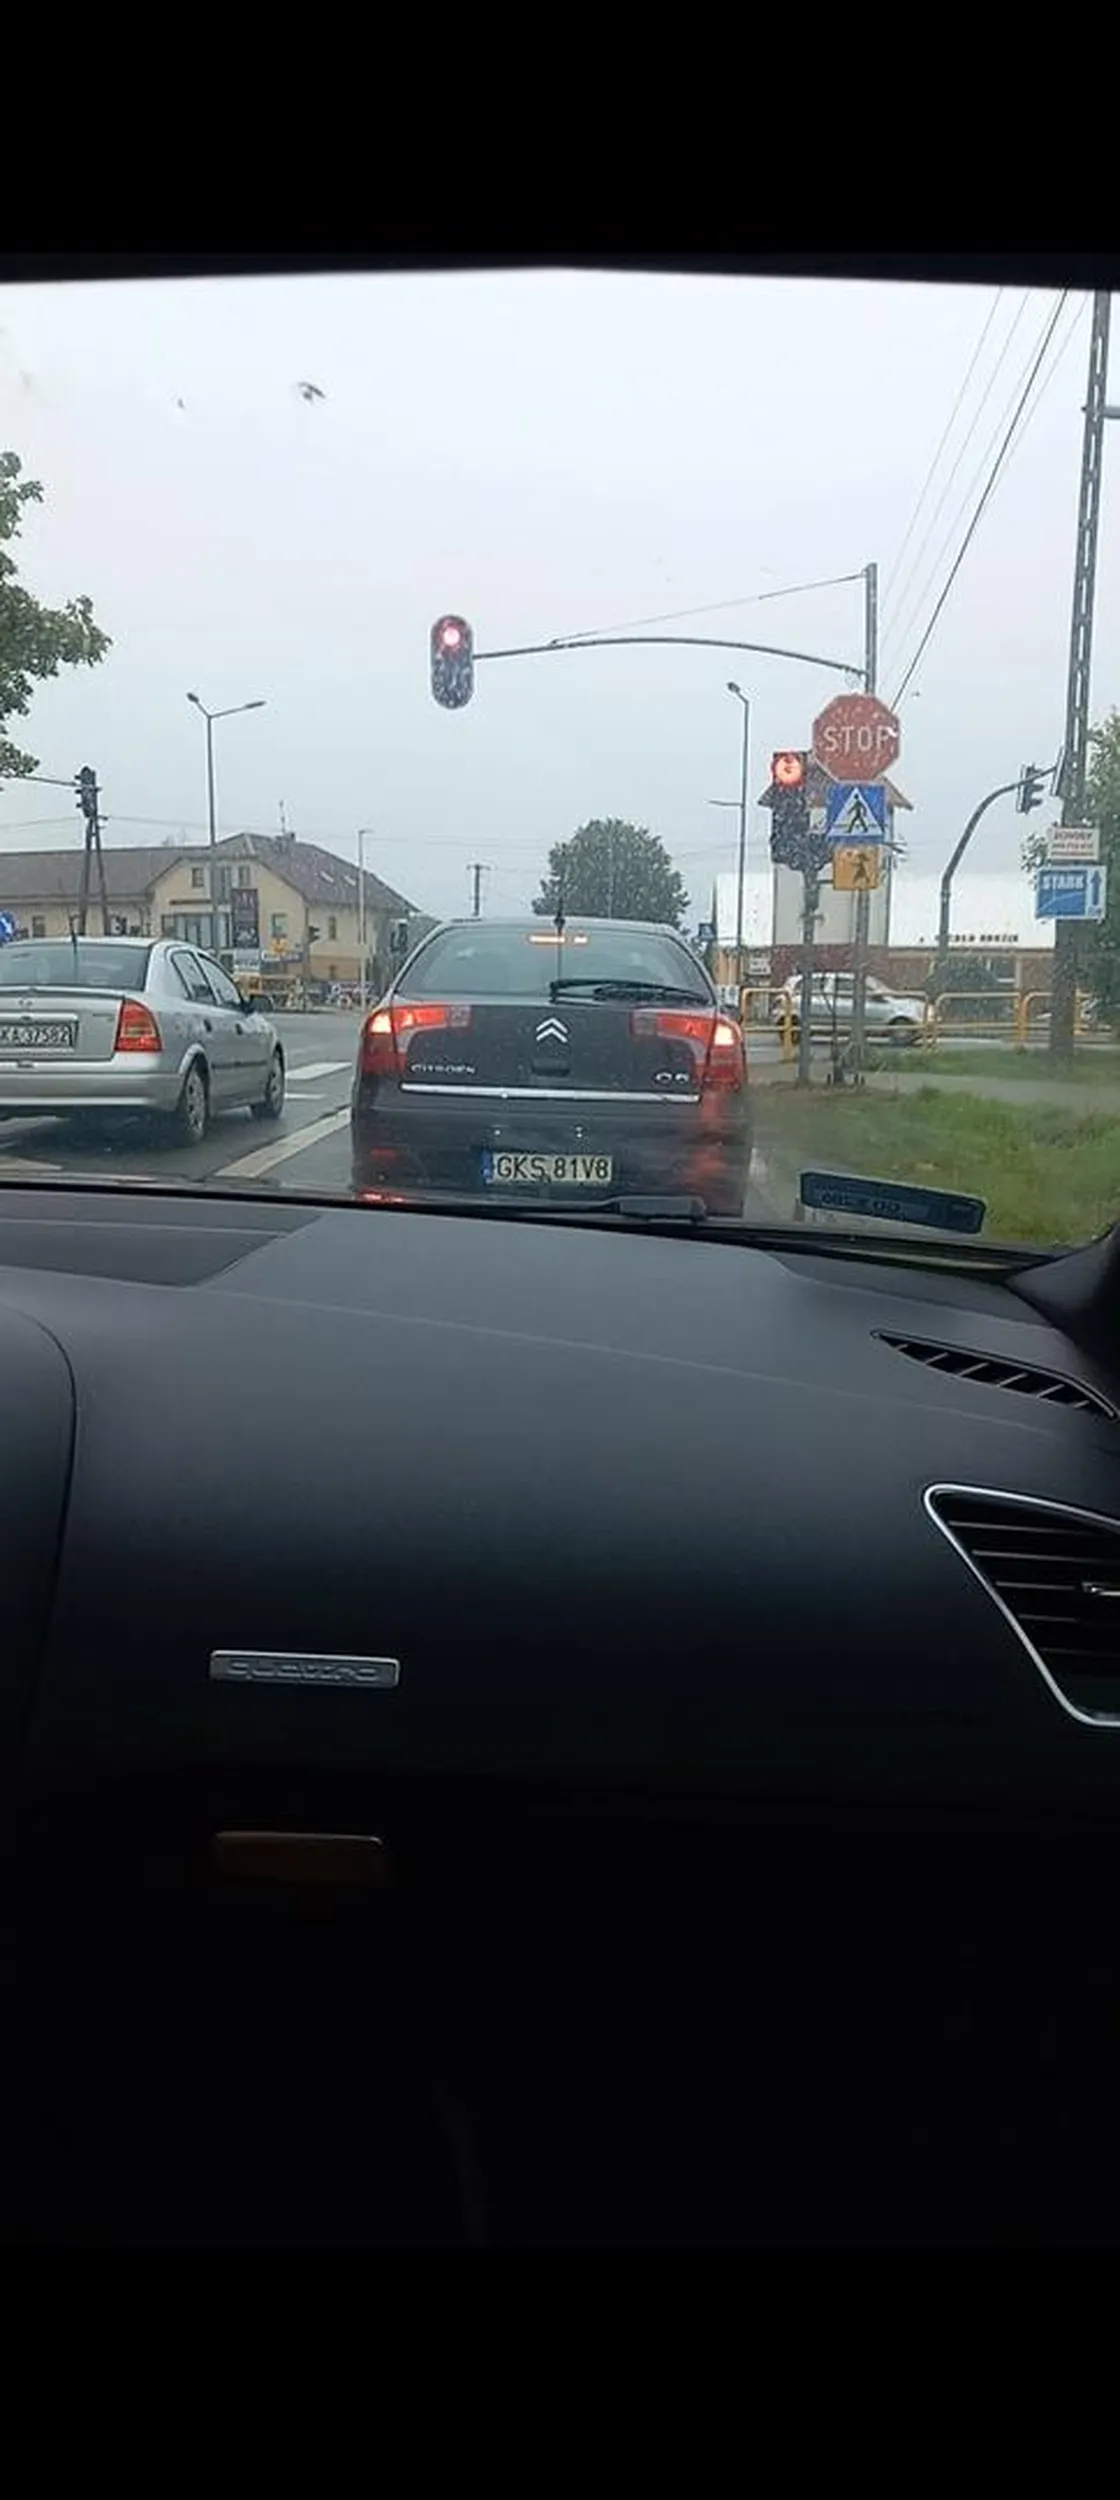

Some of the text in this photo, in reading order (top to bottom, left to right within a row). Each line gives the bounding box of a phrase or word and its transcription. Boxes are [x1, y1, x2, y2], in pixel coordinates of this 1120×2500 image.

[823, 725, 893, 753] STOP
[1042, 875, 1085, 890] STARK
[496, 1155, 609, 1180] GKS 81V8
